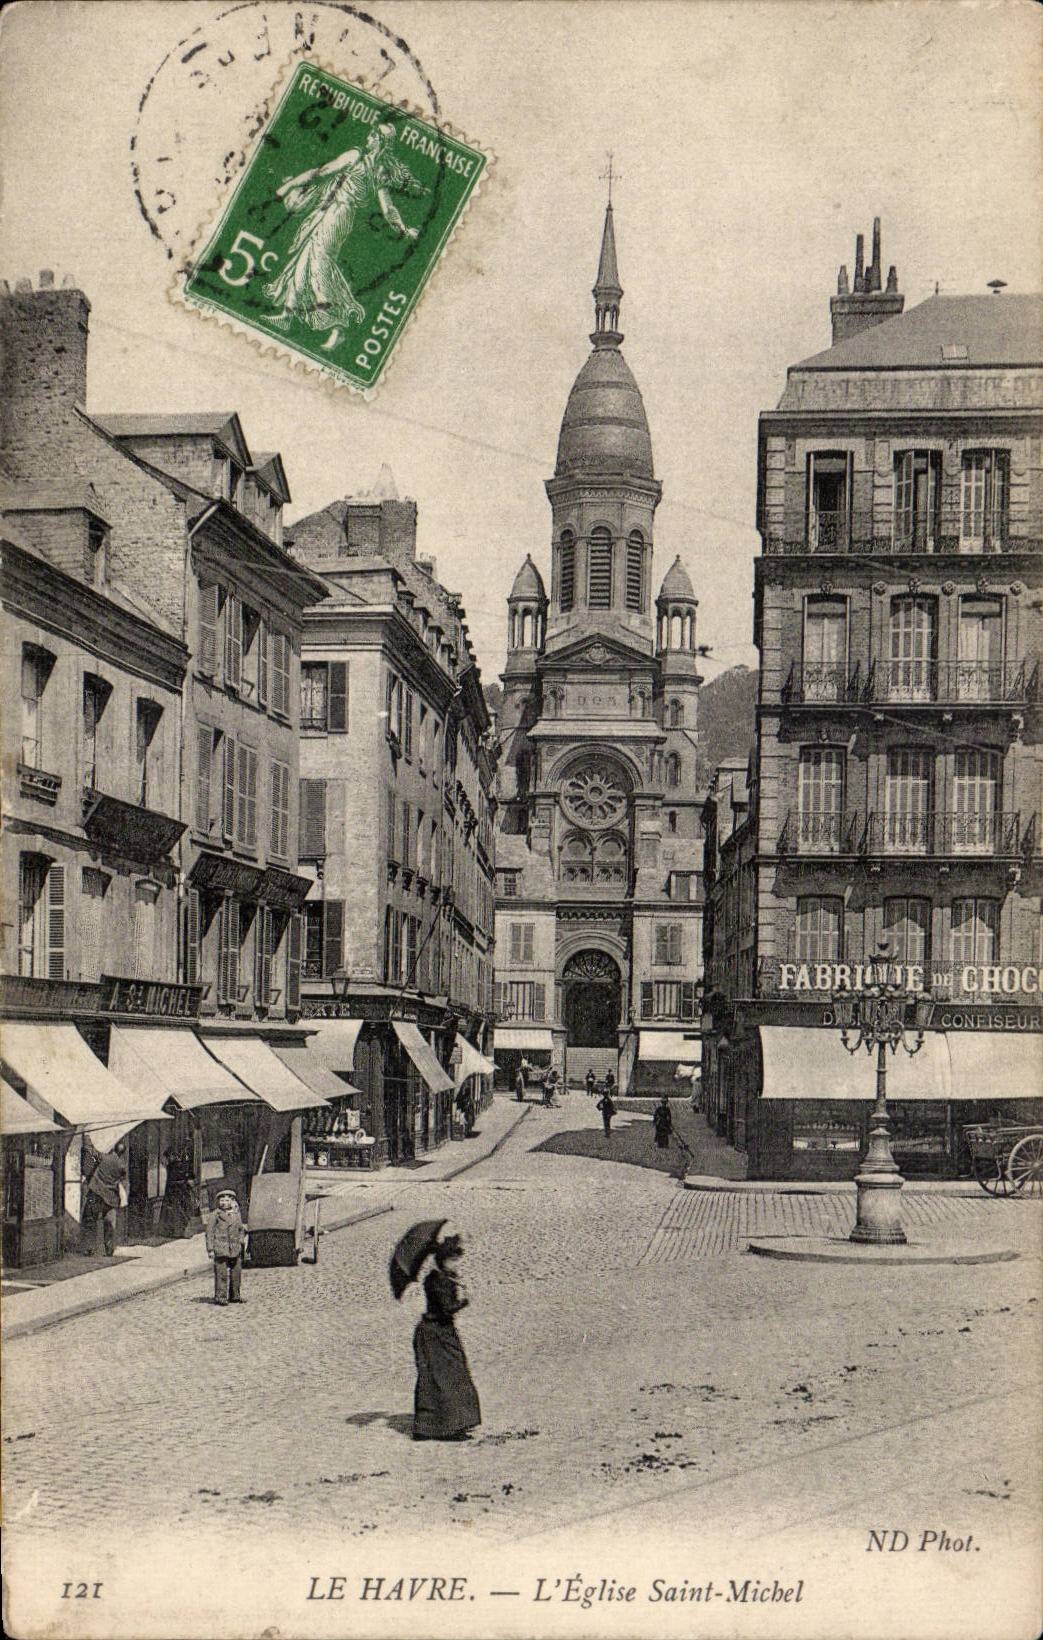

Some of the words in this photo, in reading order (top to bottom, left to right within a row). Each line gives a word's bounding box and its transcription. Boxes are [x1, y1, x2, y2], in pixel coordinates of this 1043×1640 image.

[355, 291, 407, 370] POSTES
[962, 965, 1043, 993] CHOC
[941, 1013, 1041, 1030] CONFISEUR
